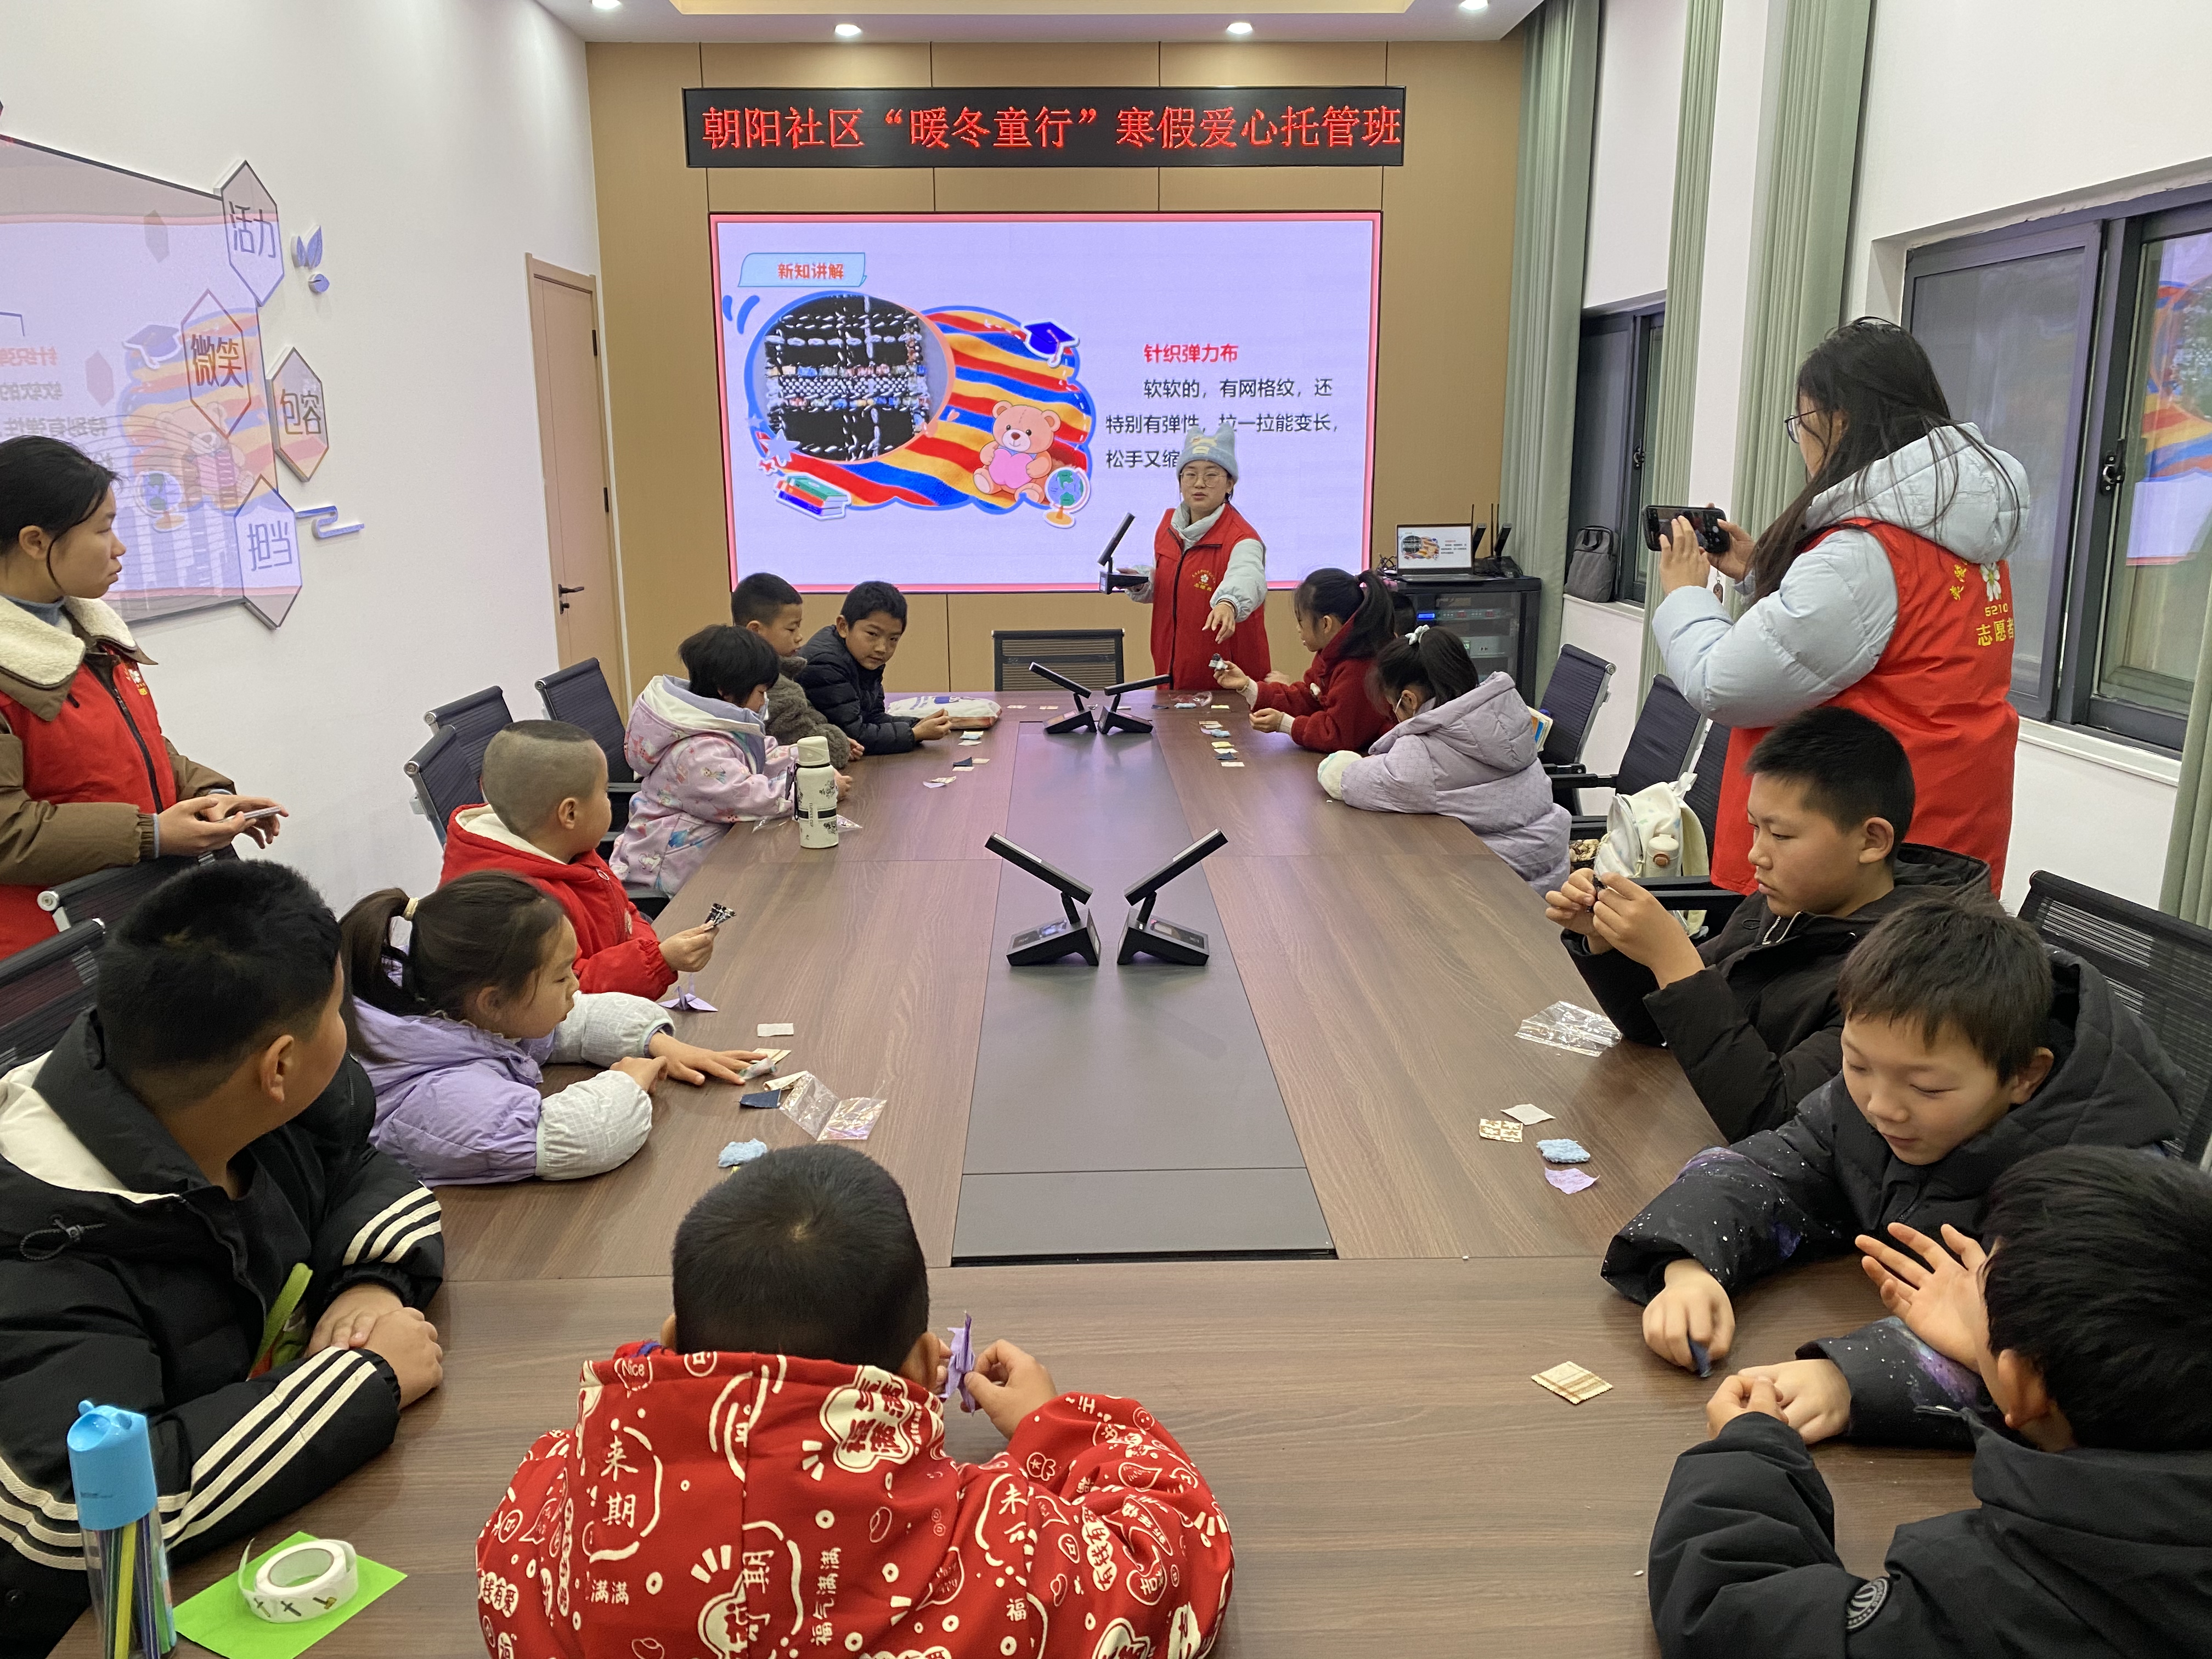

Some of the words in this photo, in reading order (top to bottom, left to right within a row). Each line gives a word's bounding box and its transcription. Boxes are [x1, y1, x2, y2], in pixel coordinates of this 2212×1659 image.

[703, 106, 1402, 149] 朝阳社区“暖冬童行”寒假爱心托管班
[228, 200, 276, 258] 活力
[777, 263, 844, 280] 新知讲解
[191, 334, 244, 388] 微笑
[1144, 343, 1238, 363] 针织弹力布
[1144, 378, 1333, 398] 软软的，有网格纹，还
[280, 390, 322, 436] 包容
[247, 520, 293, 572] 担当
[1984, 603, 2008, 617] 5210
[1975, 617, 2015, 647] 志愿者
[621, 1359, 645, 1377] Nice
[600, 1435, 639, 1529] 来期
[811, 1547, 842, 1646] 福气满满
